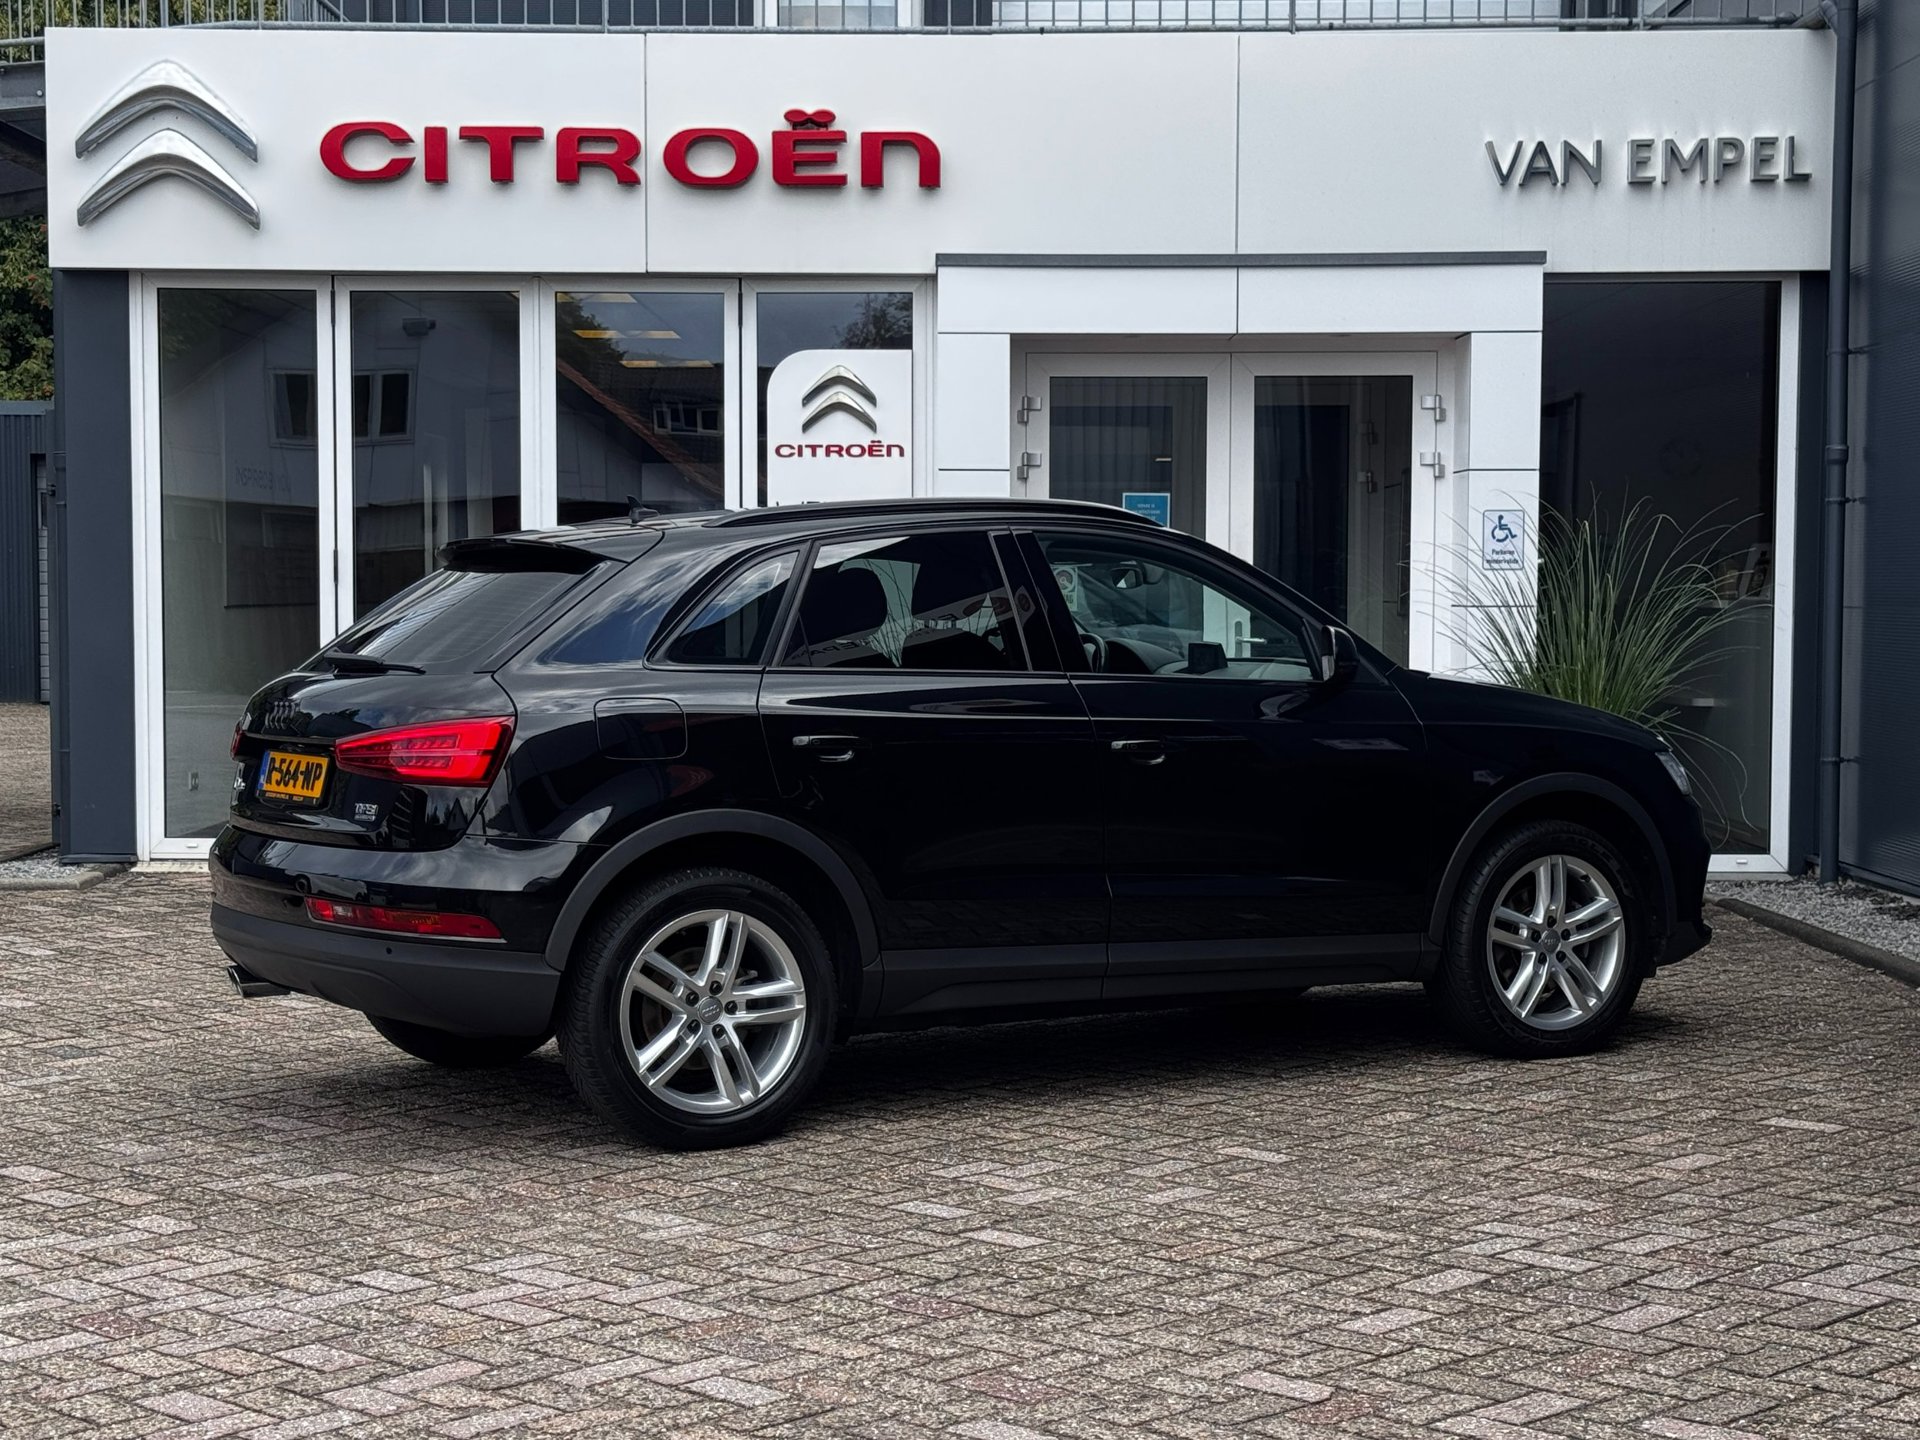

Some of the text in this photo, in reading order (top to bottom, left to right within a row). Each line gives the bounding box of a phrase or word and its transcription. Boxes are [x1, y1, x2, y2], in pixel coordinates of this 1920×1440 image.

[319, 108, 941, 189] CITROËN
[1485, 135, 1813, 186] VAN EMPEL
[774, 440, 905, 458] CITROËN
[266, 758, 323, 791] R-564-NP
